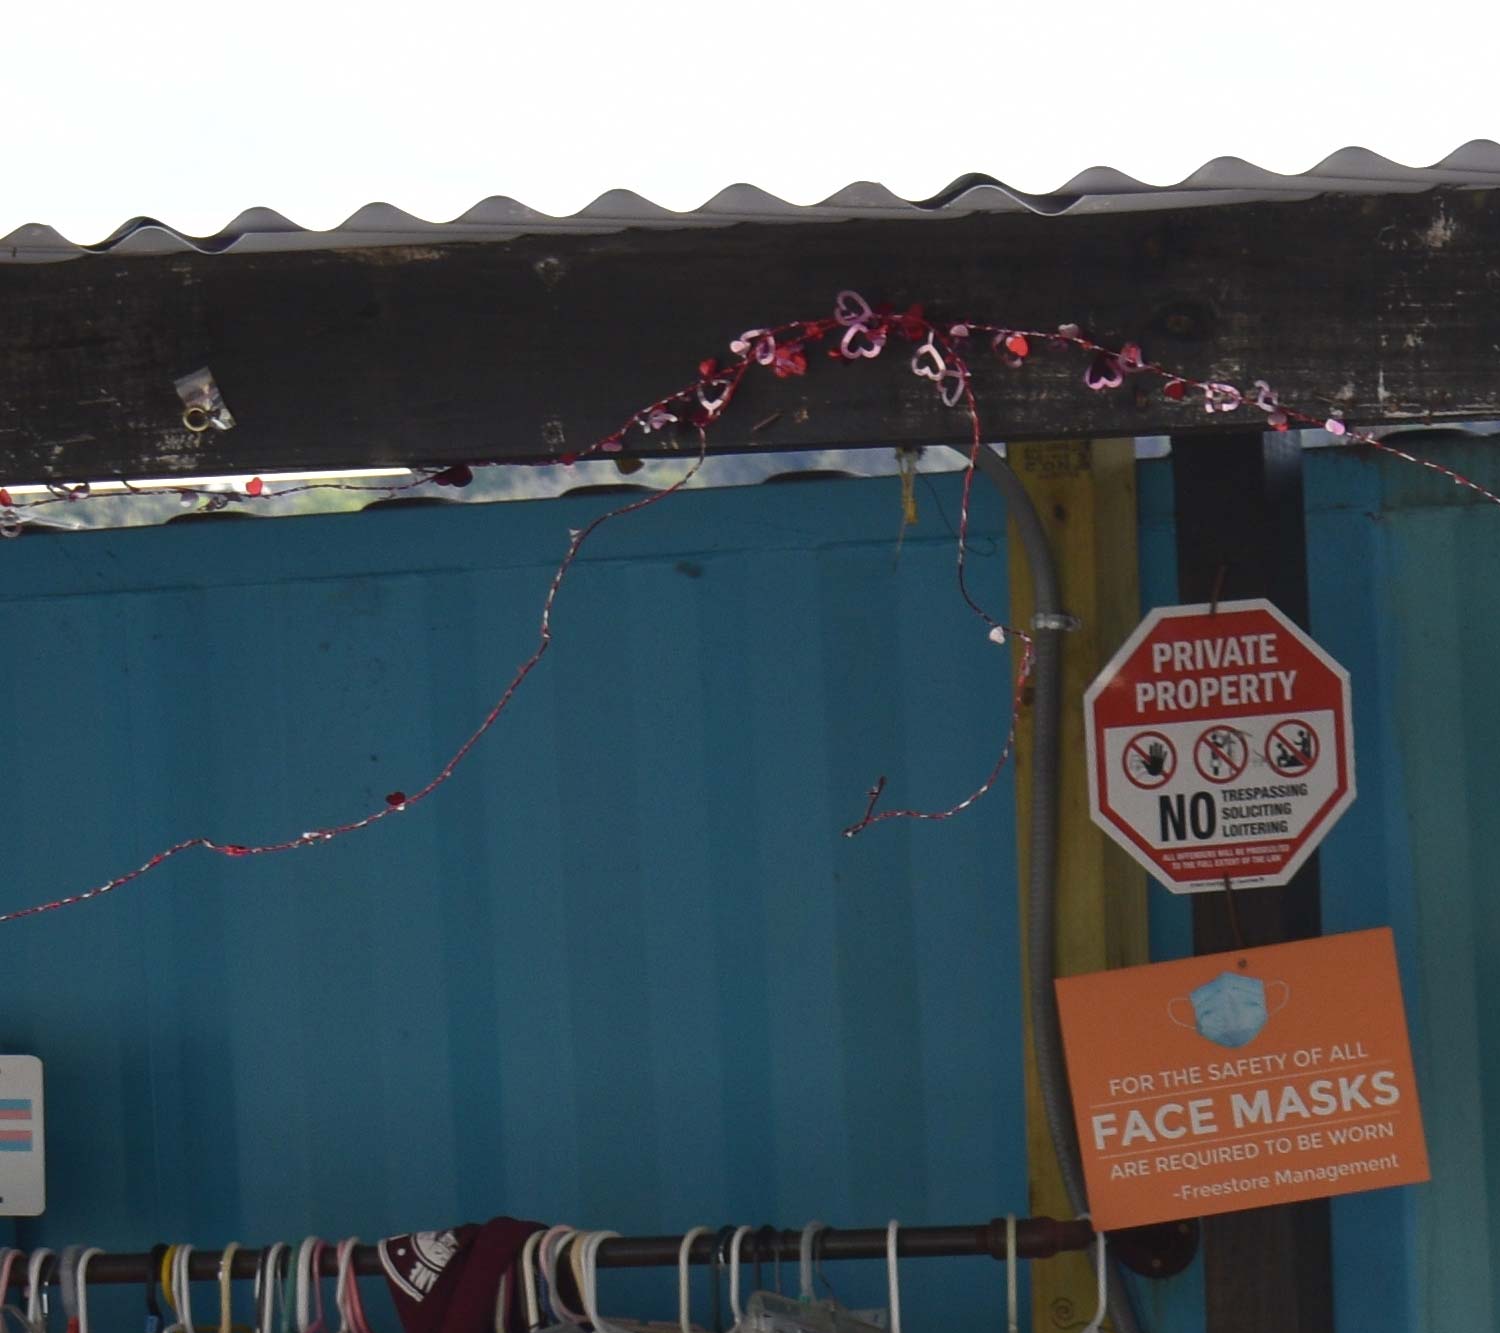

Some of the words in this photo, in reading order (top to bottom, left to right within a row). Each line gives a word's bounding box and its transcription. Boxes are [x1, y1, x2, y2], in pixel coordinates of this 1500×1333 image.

[1152, 634, 1278, 673] PRIVATE
[1136, 670, 1297, 713] PROPERTY
[1222, 783, 1308, 800] TRESPASSING
[1222, 803, 1291, 819] SOLICITING
[1159, 791, 1217, 842] NO
[1223, 821, 1288, 837] LOITERING
[1109, 1075, 1154, 1096] FOR
[1159, 1067, 1202, 1088] THE
[1208, 1053, 1287, 1081] SAFETY
[1294, 1049, 1322, 1068] OF
[1330, 1042, 1369, 1061] ALL
[1092, 1098, 1218, 1149] FACE
[1231, 1071, 1399, 1128] MASKS
[1111, 1160, 1149, 1181] ARE
[1156, 1144, 1259, 1173] REQUIRED
[1264, 1138, 1292, 1155] TO
[1300, 1131, 1323, 1149] BE
[1328, 1122, 1394, 1145] WORN
[1174, 1176, 1269, 1201] -Freestore
[1275, 1154, 1399, 1185] Management
